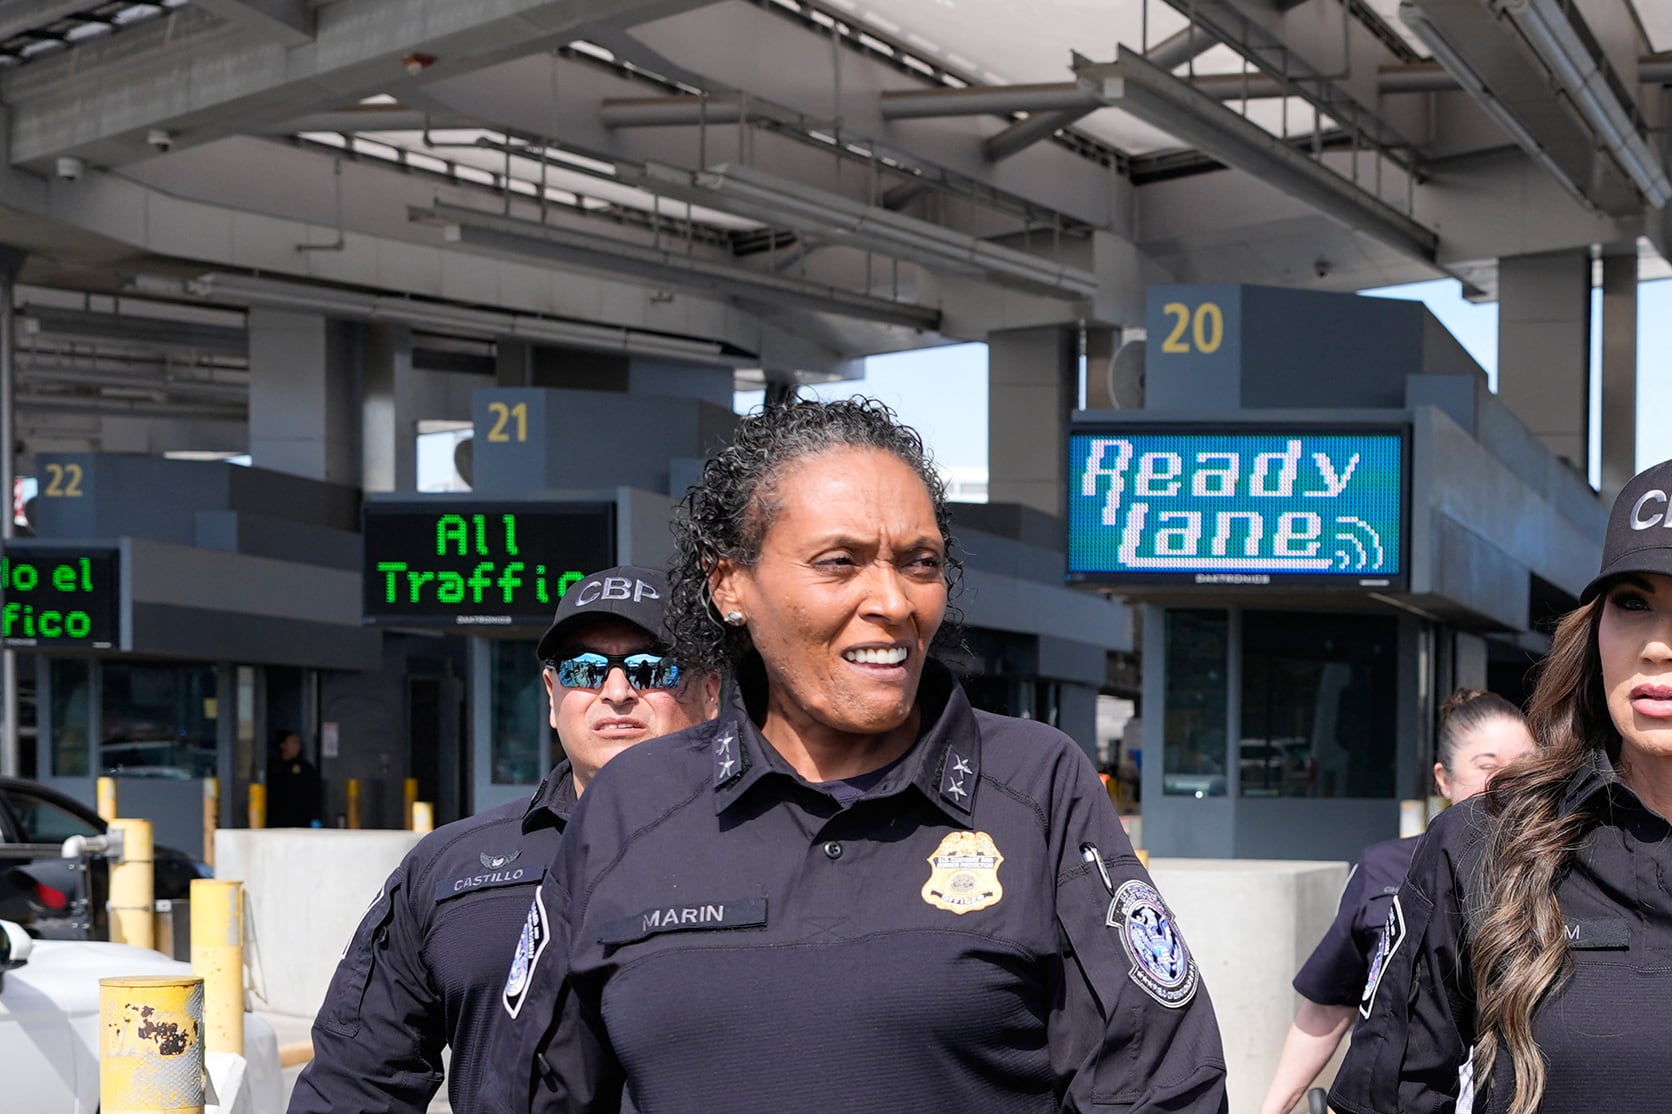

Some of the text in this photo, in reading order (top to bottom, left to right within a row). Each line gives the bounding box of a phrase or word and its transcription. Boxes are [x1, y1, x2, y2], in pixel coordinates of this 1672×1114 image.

[1160, 302, 1224, 354] 20
[487, 401, 528, 443] 21
[45, 463, 84, 498] 22
[1081, 438, 1361, 526] Ready
[435, 513, 519, 556] All
[52, 556, 94, 592] el
[575, 577, 660, 607] CBP
[453, 868, 524, 892] CASTILLO
[642, 904, 724, 932] MARIN
